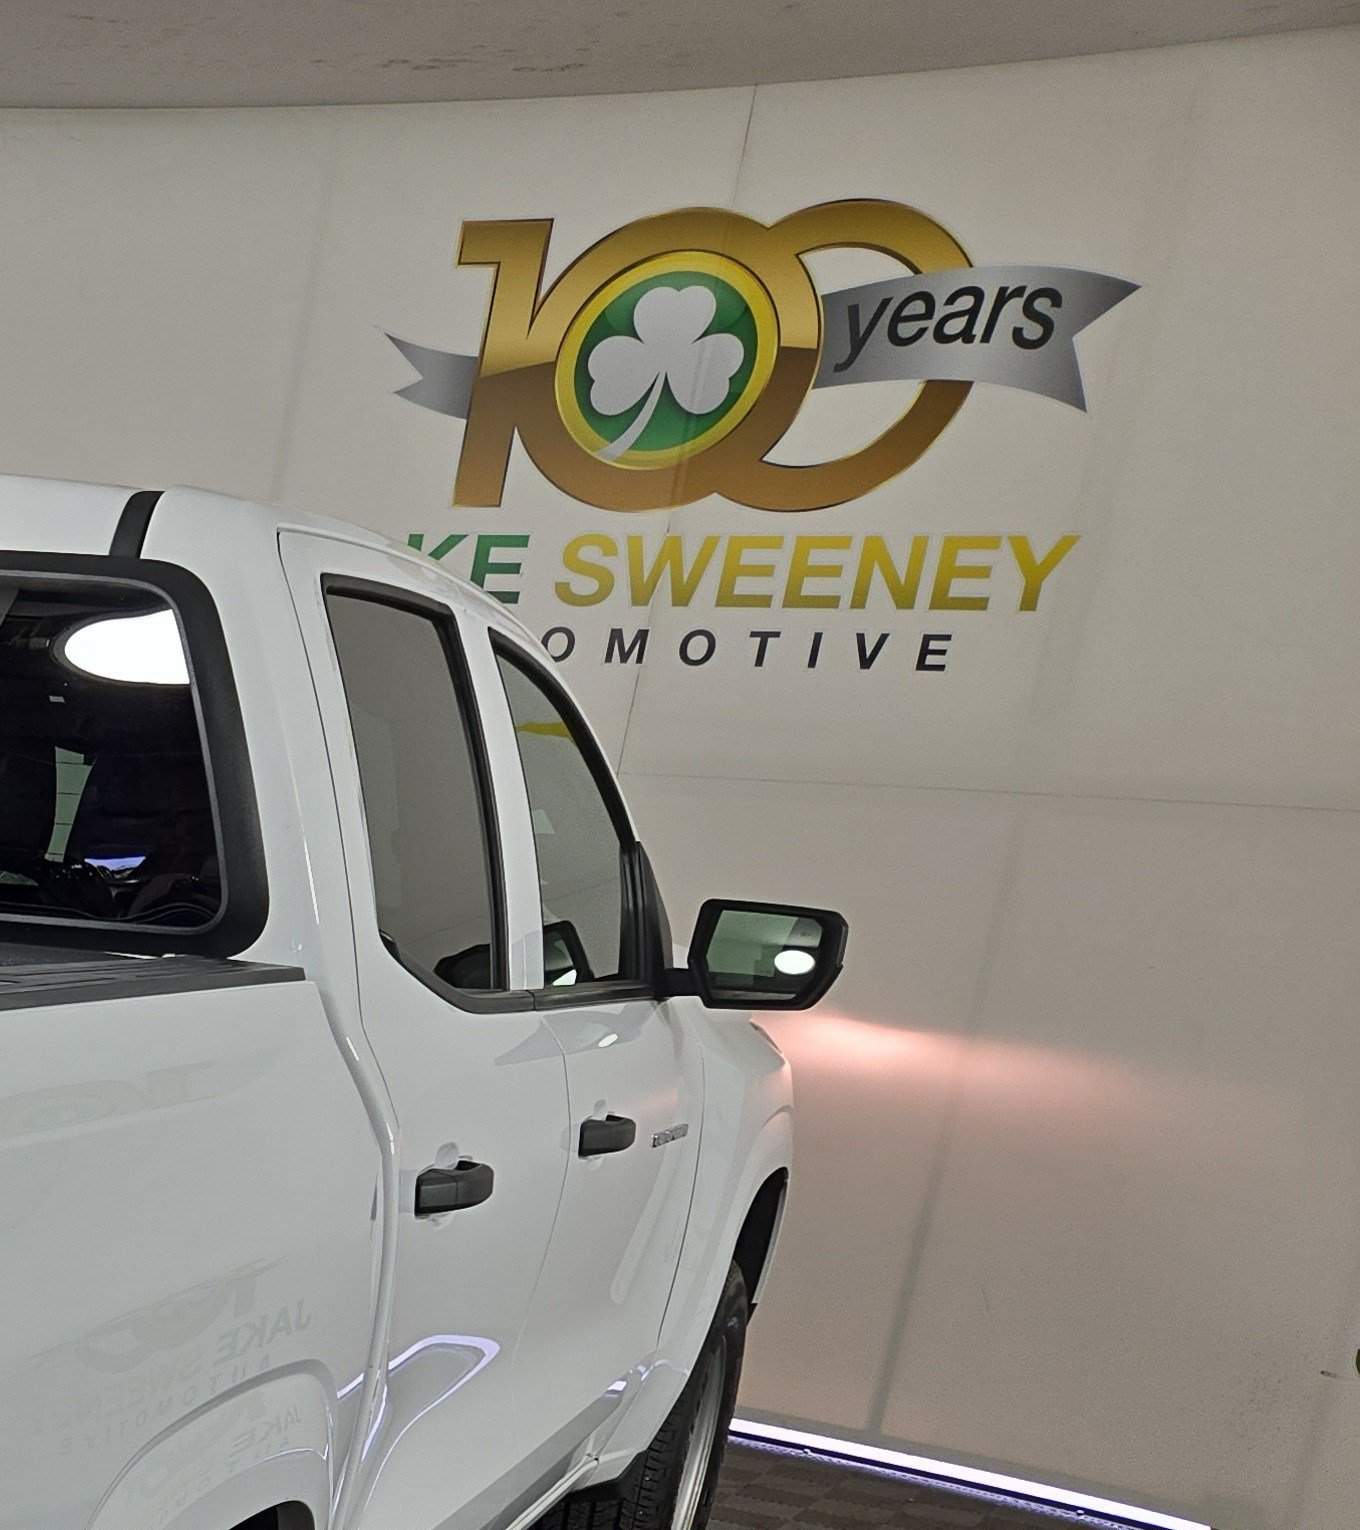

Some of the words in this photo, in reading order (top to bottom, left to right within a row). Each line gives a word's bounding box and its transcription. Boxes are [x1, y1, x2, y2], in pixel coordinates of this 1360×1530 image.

[833, 285, 1063, 373] years
[554, 532, 1080, 613] SWEENEY
[540, 625, 953, 674] OMOTIVE
